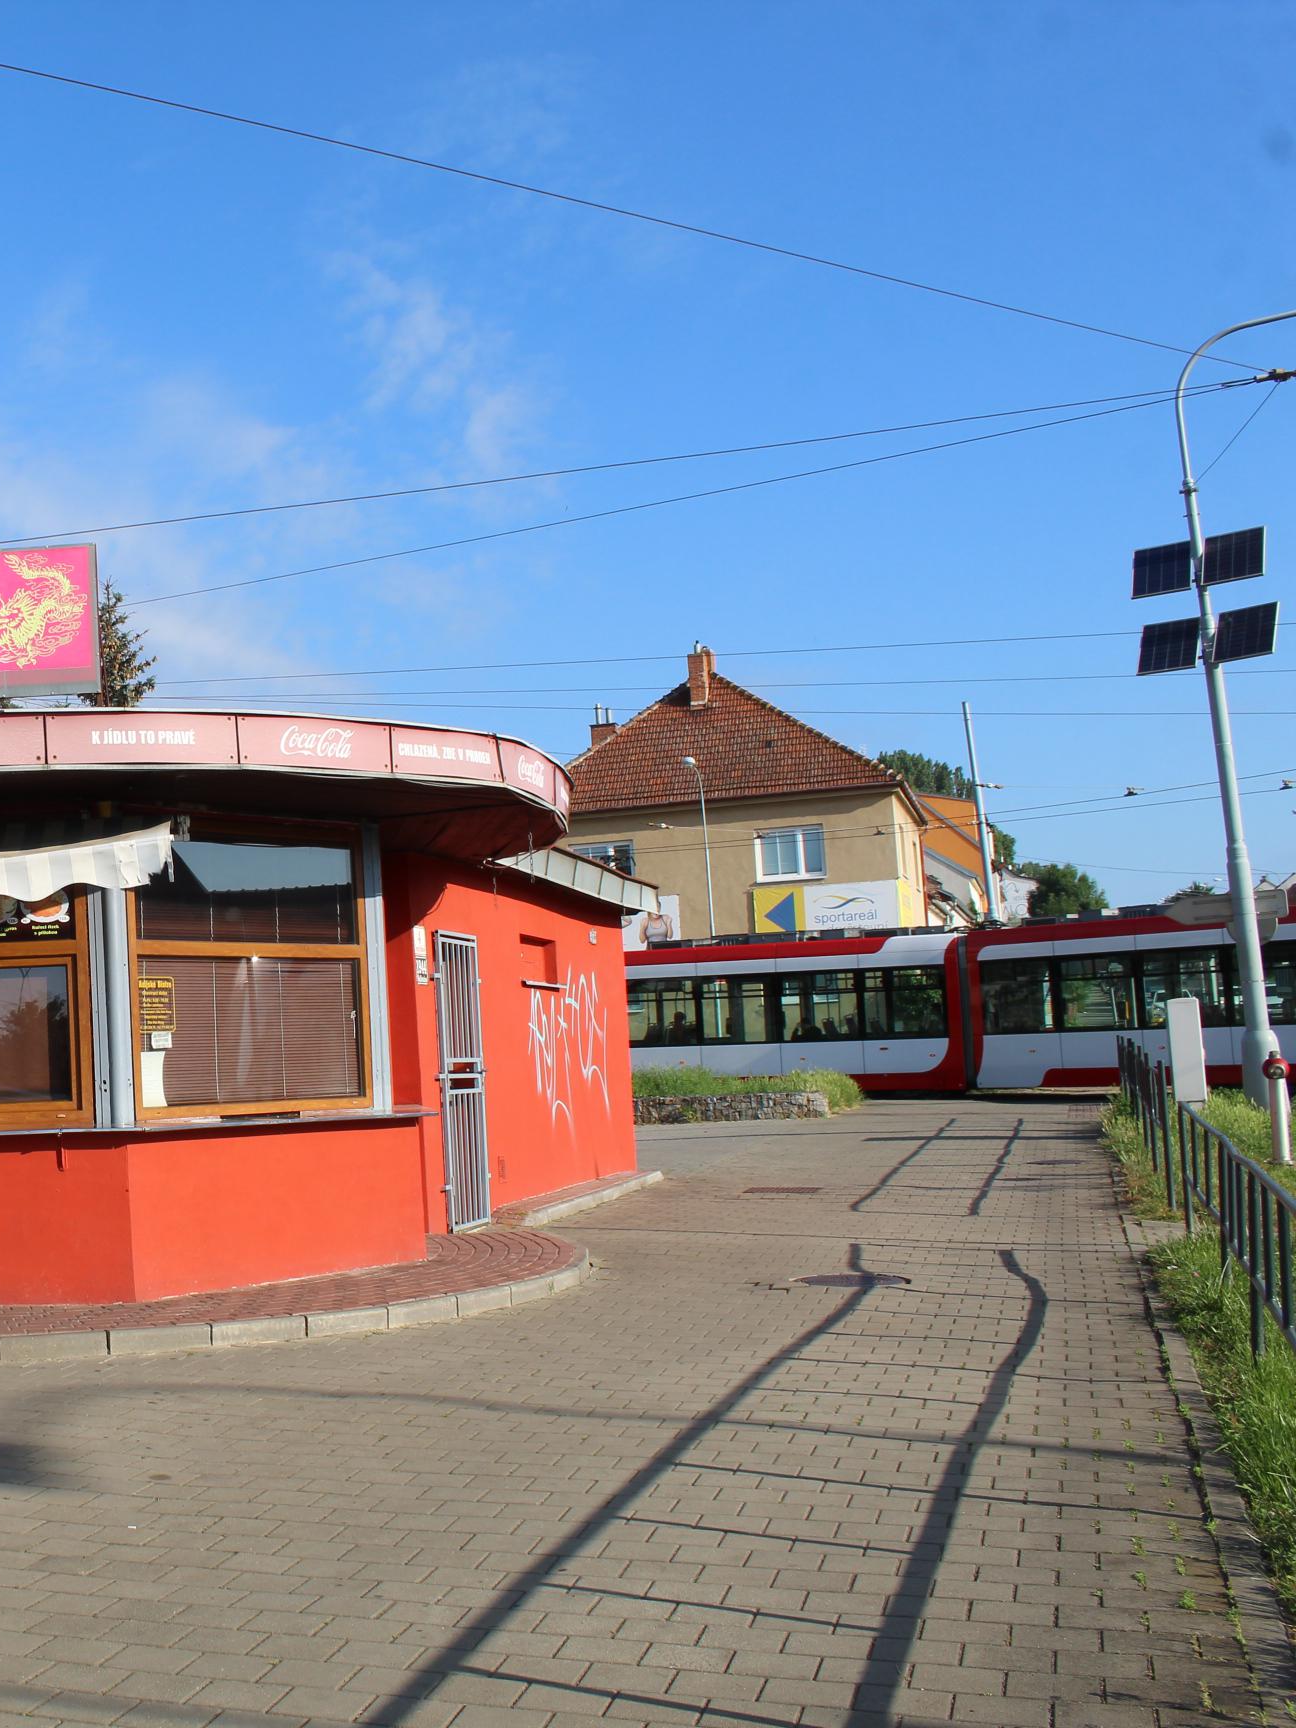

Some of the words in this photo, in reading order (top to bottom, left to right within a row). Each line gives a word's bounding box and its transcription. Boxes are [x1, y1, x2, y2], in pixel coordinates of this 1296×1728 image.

[91, 730, 101, 745] K
[102, 727, 137, 745] JÍDLU
[139, 730, 155, 745] TO
[157, 728, 196, 745] PRAVÉ
[814, 908, 878, 925] sportareál
